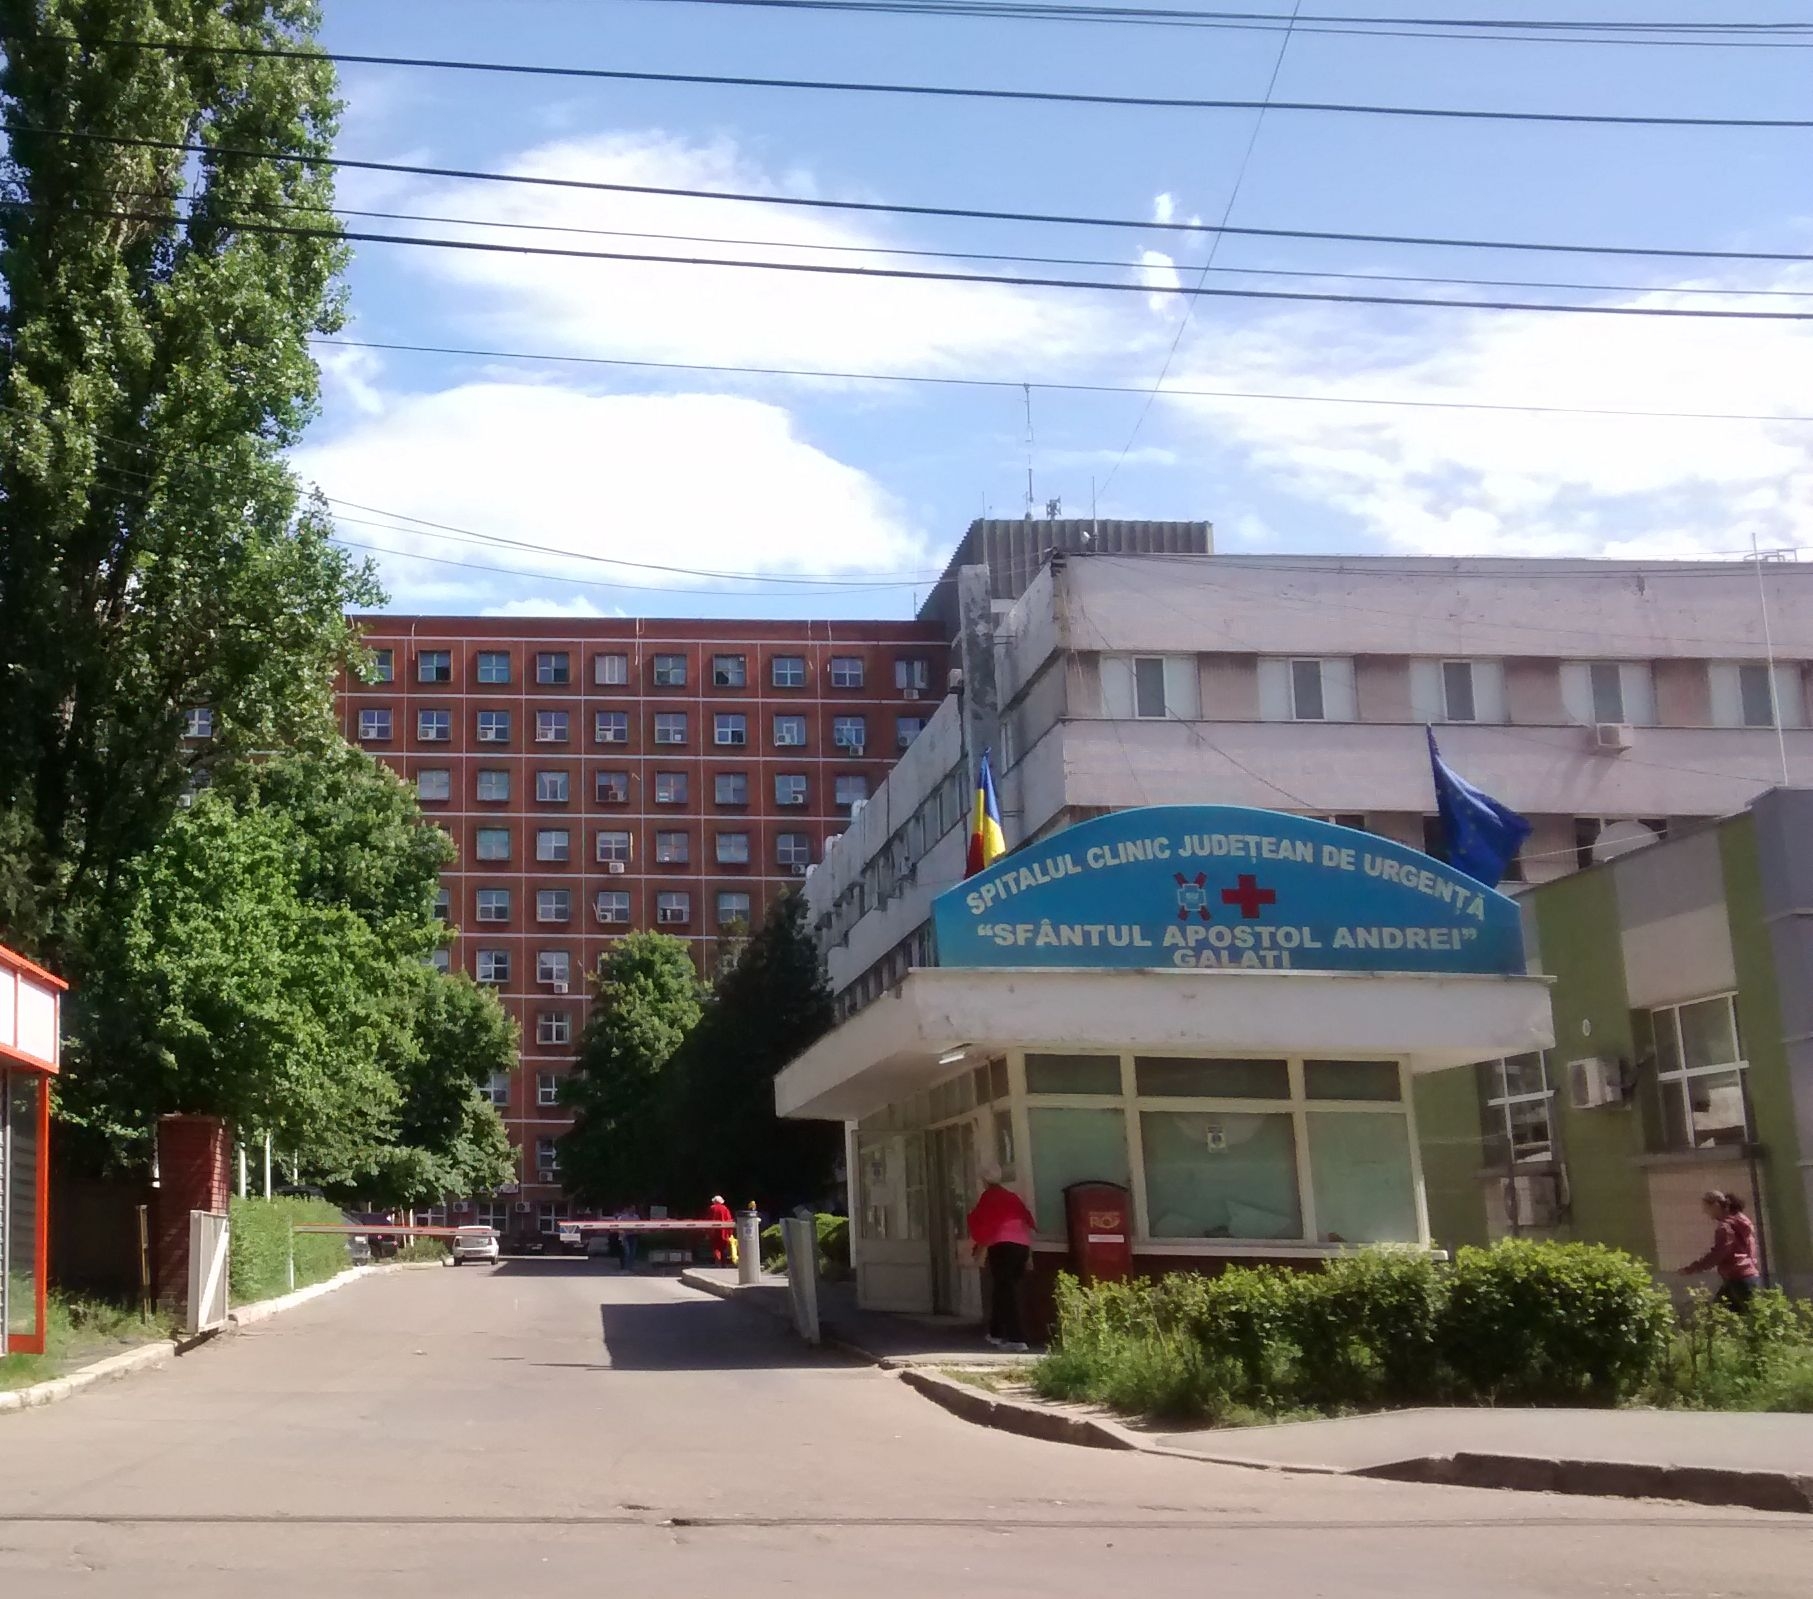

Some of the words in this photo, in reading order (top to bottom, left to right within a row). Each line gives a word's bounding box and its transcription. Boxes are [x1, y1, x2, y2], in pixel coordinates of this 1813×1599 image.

[967, 854, 1081, 915] SPITALUL
[1087, 836, 1171, 869] CLINIC
[1322, 845, 1356, 871] DE
[1162, 925, 1322, 948] APOSTOL
